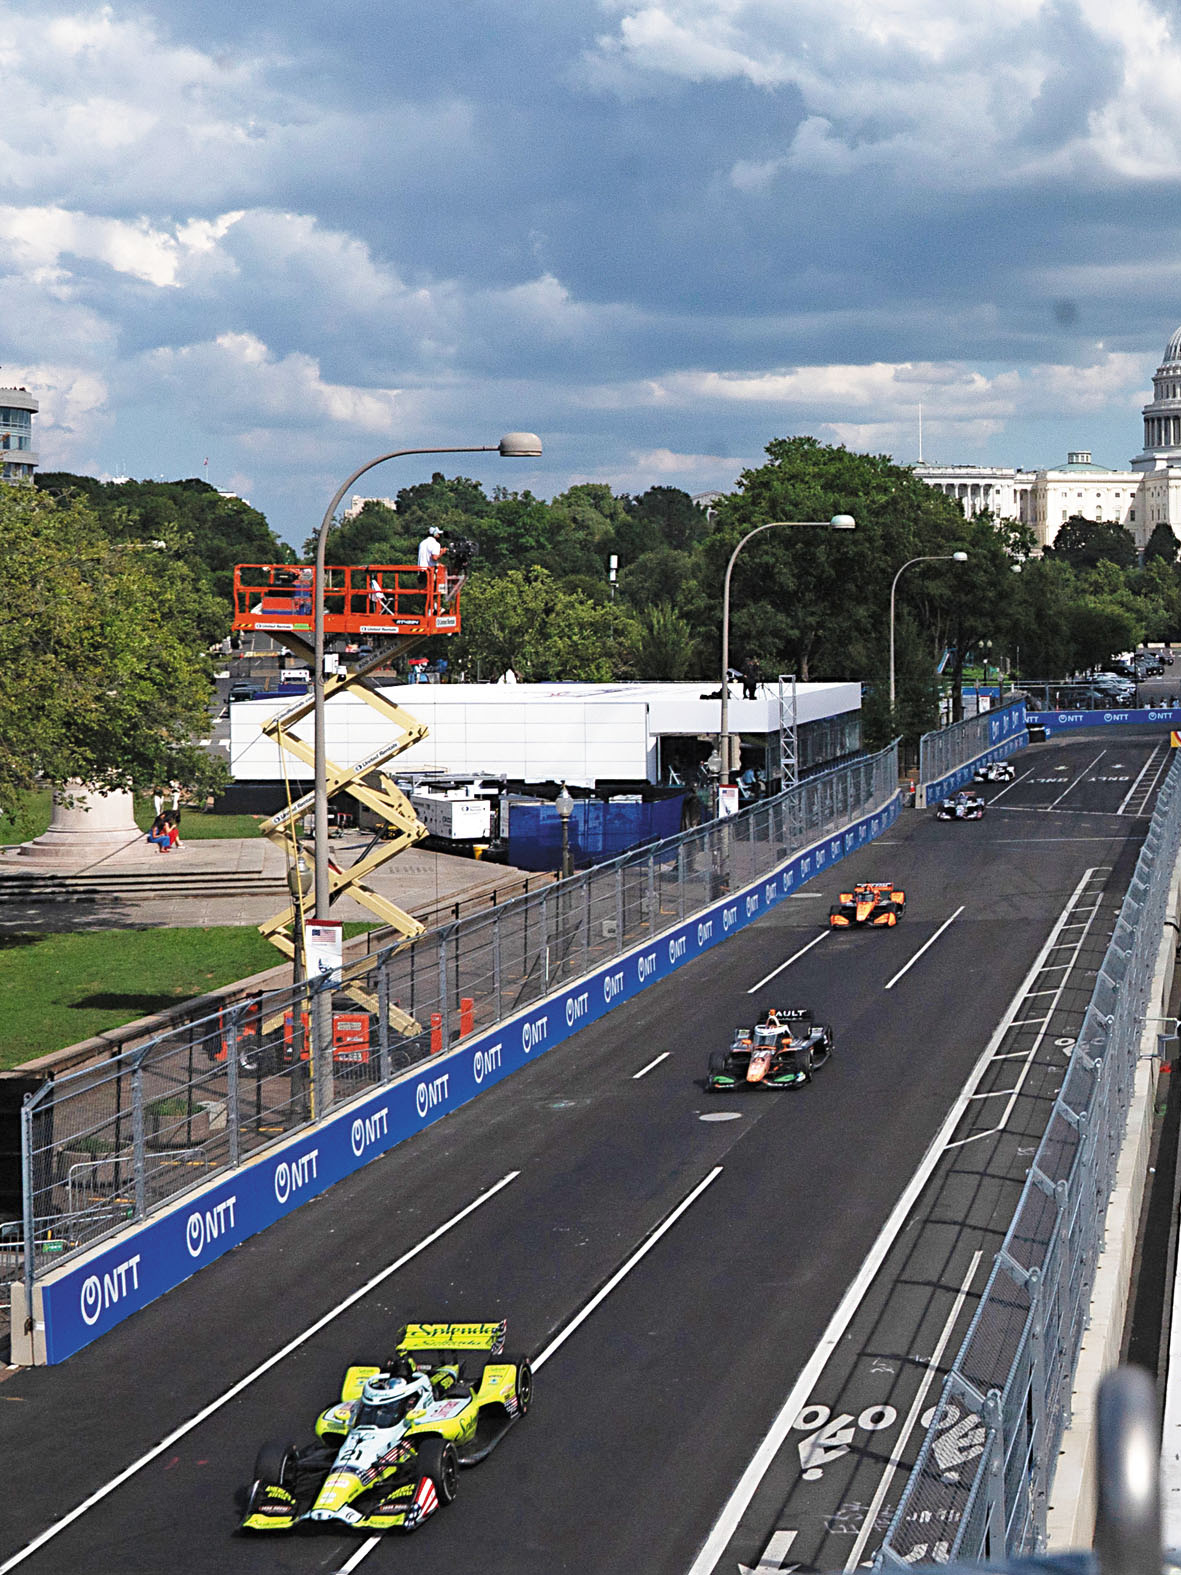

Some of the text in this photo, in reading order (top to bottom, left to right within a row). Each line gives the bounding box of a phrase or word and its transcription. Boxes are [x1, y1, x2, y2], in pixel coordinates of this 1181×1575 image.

[646, 953, 656, 976] NTT
[609, 971, 623, 995] NTT
[573, 992, 588, 1016] NTT
[769, 1009, 807, 1017] AULT
[532, 1016, 548, 1044] NTT
[484, 1044, 502, 1075] NTT
[428, 1074, 448, 1107] NTT
[365, 1108, 388, 1145] NTT
[291, 1149, 318, 1191] NTT
[204, 1196, 236, 1243] NTT
[104, 1254, 140, 1308] NTT
[411, 1323, 499, 1341] Splenda
[340, 1449, 363, 1460] 21
